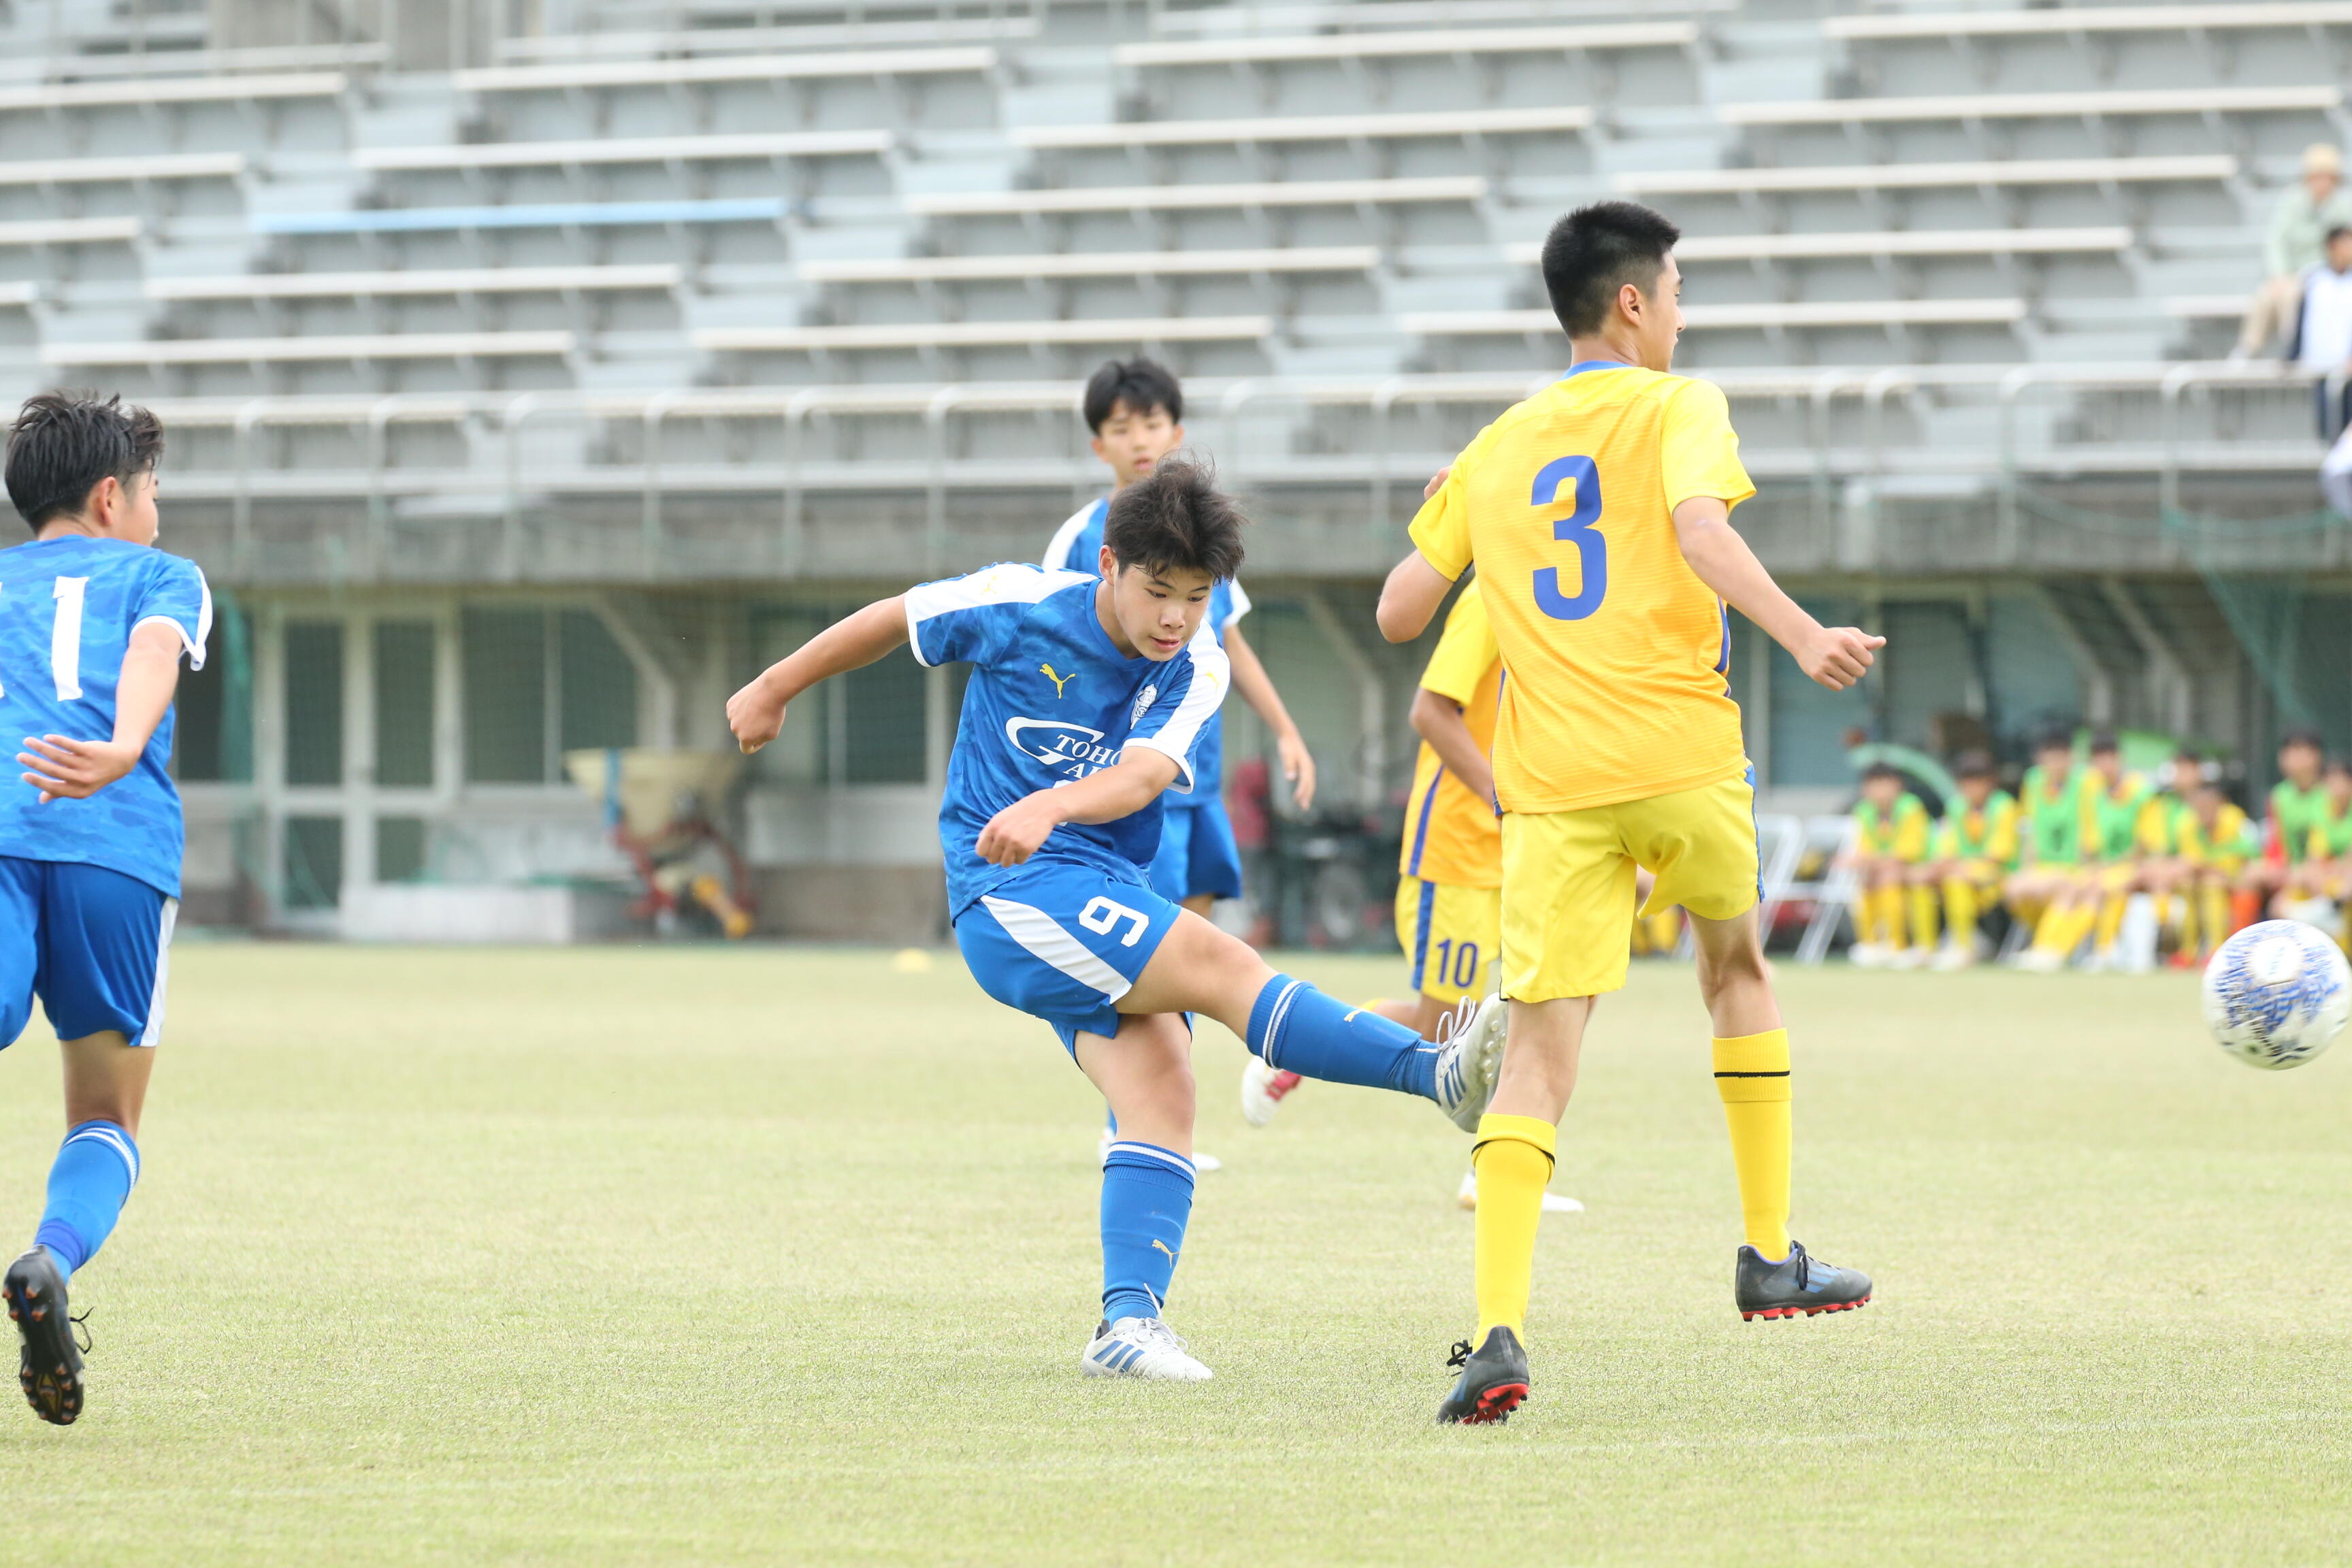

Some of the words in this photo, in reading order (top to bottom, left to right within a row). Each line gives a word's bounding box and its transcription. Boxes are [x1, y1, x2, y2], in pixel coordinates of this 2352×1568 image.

[1531, 455, 1607, 621] 3
[1078, 895, 1149, 947] 9
[1437, 938, 1479, 989] 10
